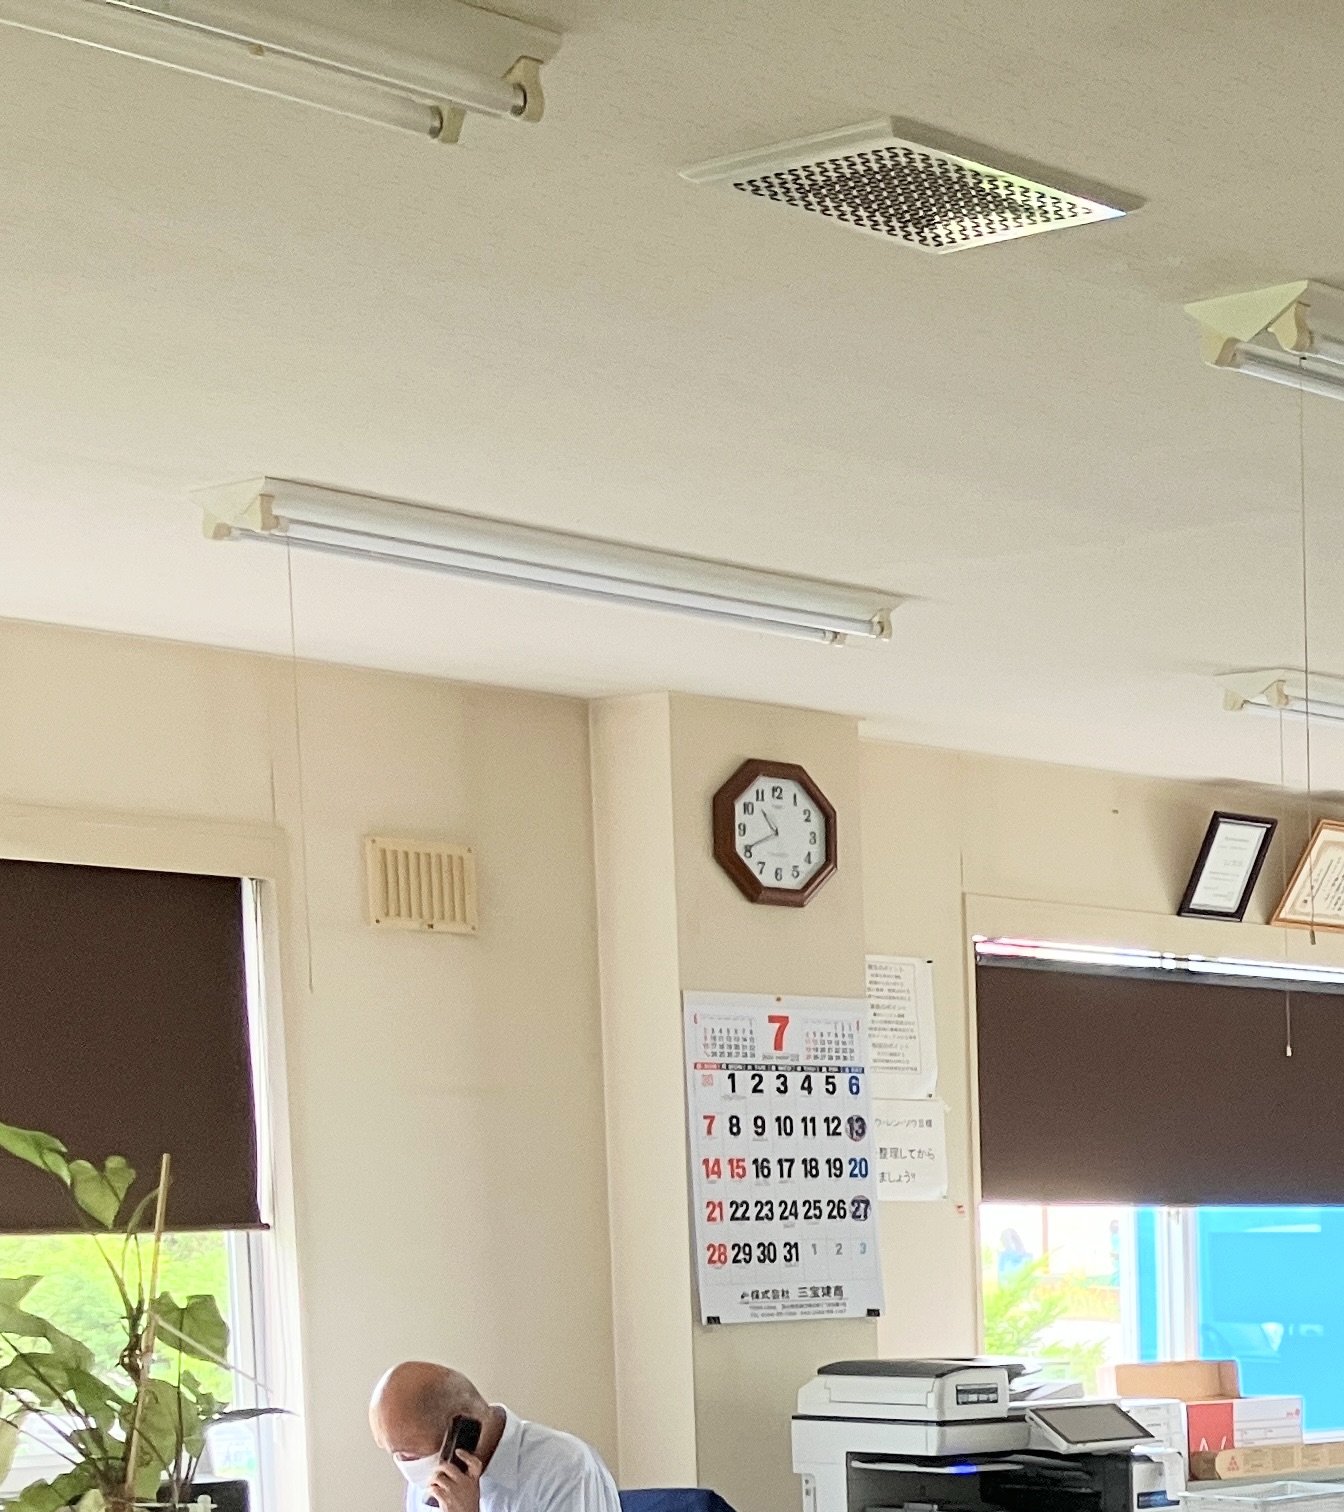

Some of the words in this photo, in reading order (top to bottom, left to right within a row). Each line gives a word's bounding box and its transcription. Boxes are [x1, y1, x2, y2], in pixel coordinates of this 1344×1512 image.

[755, 788, 765, 802] 11
[771, 785, 784, 800] 12
[792, 792, 798, 807] 1
[742, 801, 755, 816] 10
[802, 808, 812, 823] 2
[737, 822, 747, 837] 9
[808, 831, 817, 846] 3
[743, 844, 753, 859] 8
[803, 850, 812, 865] 4
[756, 861, 767, 875] 7
[774, 867, 783, 882] 6
[791, 865, 800, 879] 5
[768, 1015, 790, 1051] 7
[726, 1070, 739, 1094] 1
[750, 1072, 764, 1094] 2
[774, 1073, 790, 1096] 3
[800, 1074, 814, 1096] 4
[824, 1074, 838, 1096] 5
[848, 1073, 862, 1096] 6
[702, 1114, 716, 1136] 7
[728, 1114, 742, 1137] 8
[752, 1115, 766, 1138] 9
[774, 1115, 794, 1137] 10
[800, 1116, 818, 1137] 11
[823, 1116, 842, 1138] 12
[702, 1157, 722, 1180] 14
[727, 1157, 747, 1180] 15
[752, 1157, 772, 1180] 16
[776, 1157, 796, 1179] 17
[801, 1157, 820, 1179] 18
[825, 1157, 844, 1179] 19
[848, 1157, 869, 1179] 20
[705, 1200, 724, 1223] 21
[729, 1199, 751, 1222] 22
[754, 1199, 775, 1222] 23
[778, 1199, 799, 1221] 24
[802, 1199, 823, 1220] 25
[826, 1198, 847, 1220] 26
[851, 1199, 870, 1221] 27
[706, 1242, 728, 1266] 28
[730, 1242, 753, 1265] 29
[756, 1241, 777, 1264] 30
[782, 1241, 800, 1263] 31
[811, 1242, 818, 1256] 1
[835, 1242, 844, 1256] 2
[858, 1242, 868, 1256] 3
